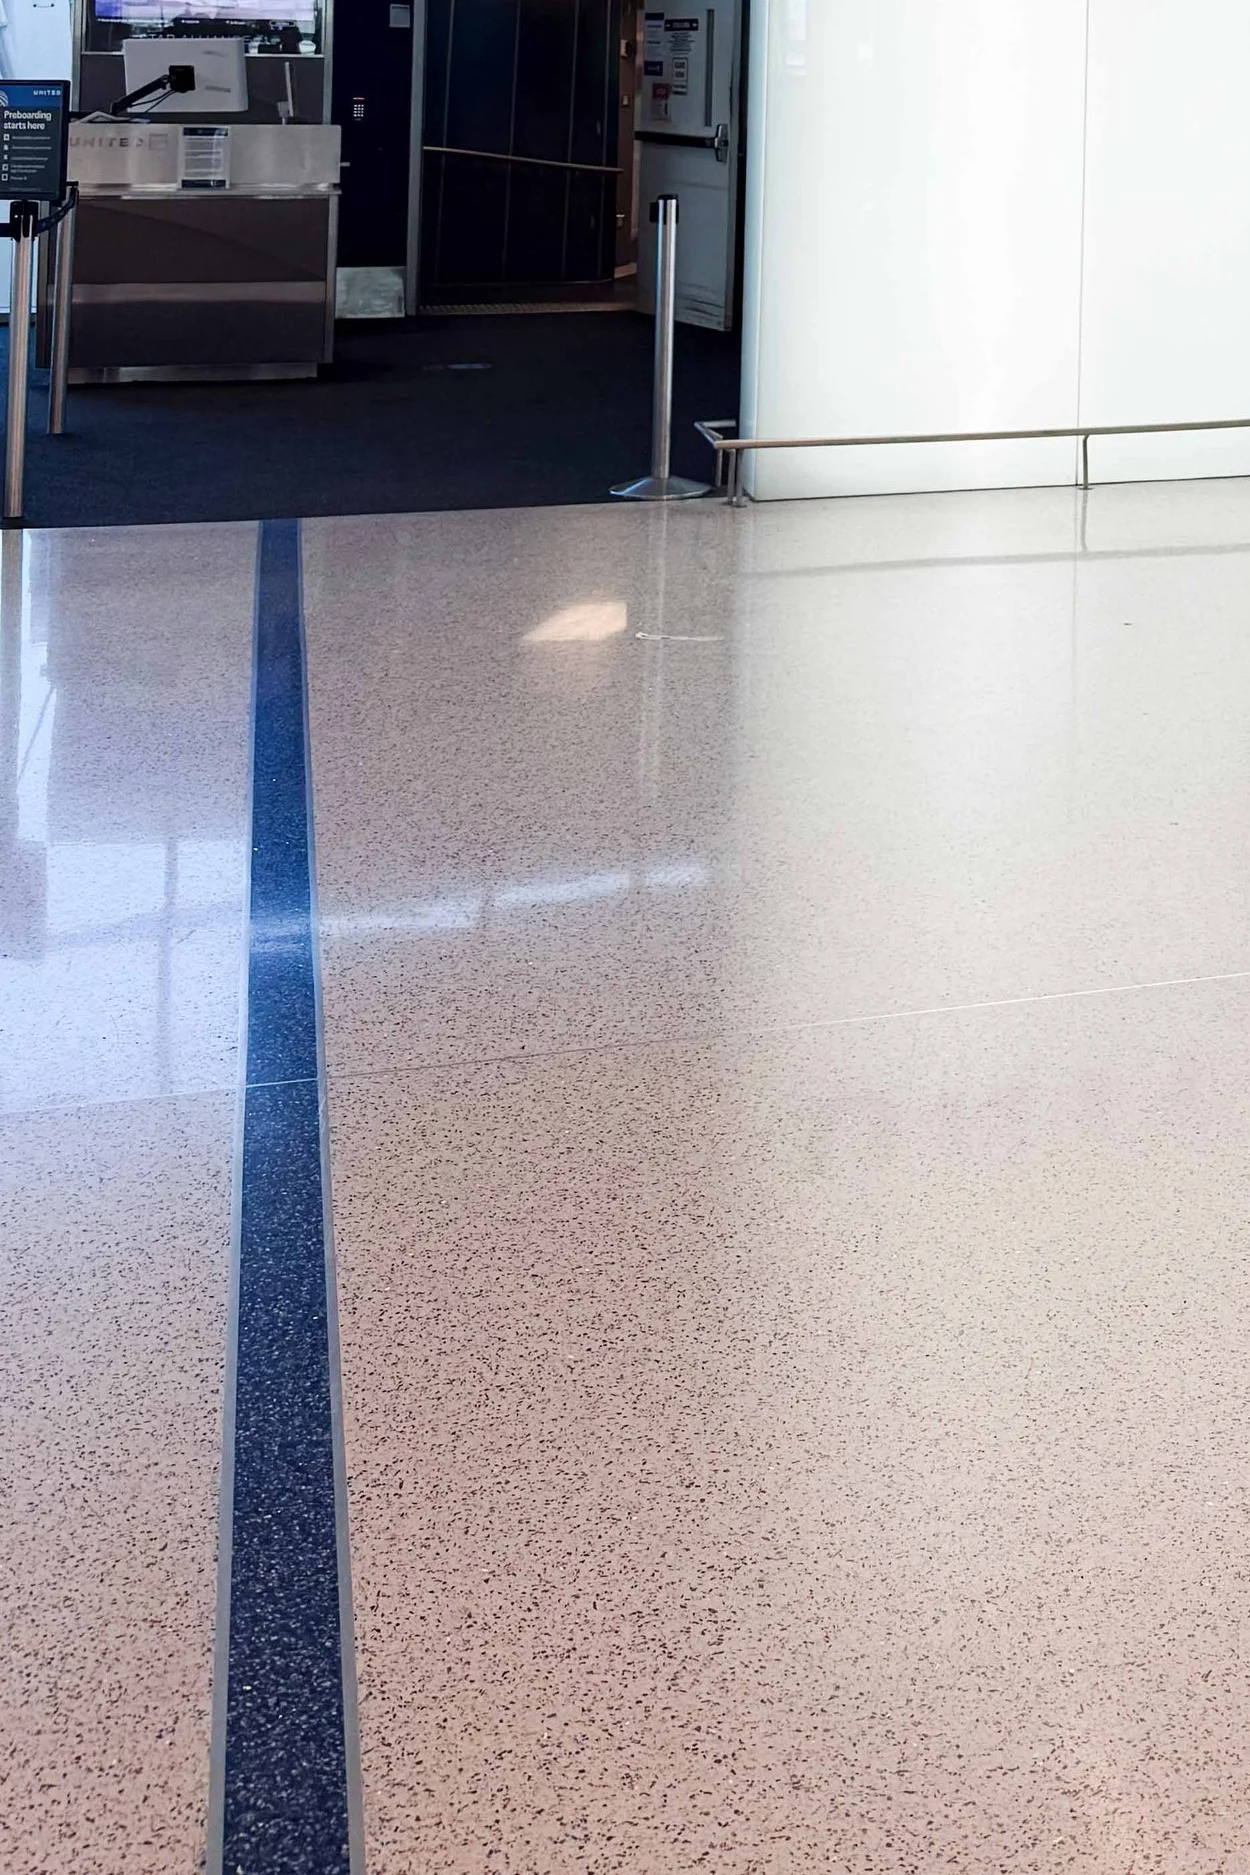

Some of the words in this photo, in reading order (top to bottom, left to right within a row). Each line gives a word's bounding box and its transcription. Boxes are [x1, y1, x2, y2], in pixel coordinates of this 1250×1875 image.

[4, 110, 52, 121] Preboarding
[3, 121, 27, 130] starts
[27, 121, 45, 130] here
